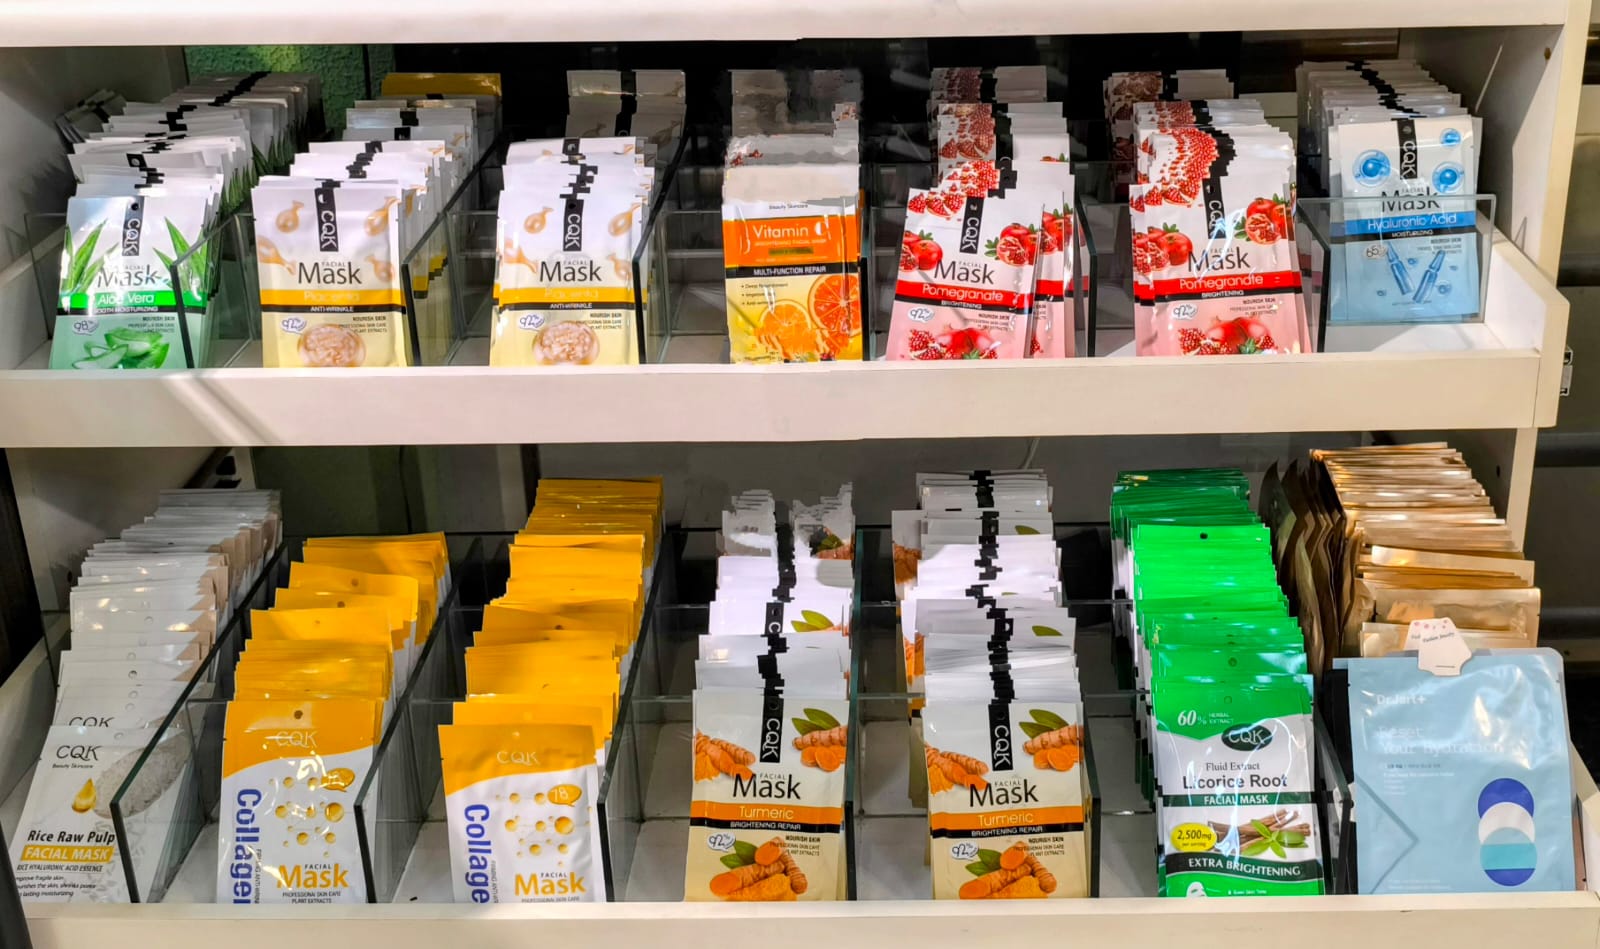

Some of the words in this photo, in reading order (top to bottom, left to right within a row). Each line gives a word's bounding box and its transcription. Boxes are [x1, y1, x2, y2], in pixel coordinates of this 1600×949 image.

[1401, 140, 1416, 177] CQK
[1381, 187, 1440, 213] Mask
[321, 210, 338, 249] CQK
[1368, 216, 1427, 231] Hyaluronic
[1430, 213, 1457, 225] Acid
[122, 218, 141, 256] CQK
[564, 213, 581, 249] CQK
[753, 224, 809, 239] Vitamin
[961, 217, 980, 251] CQK
[1392, 230, 1434, 238] MOISTURIZING
[958, 261, 983, 269] FACIAL
[1188, 246, 1251, 272] Mask
[97, 264, 159, 288] Mask
[298, 261, 363, 284] Mask
[540, 260, 602, 282] Mask
[754, 267, 803, 276] MULTI-FUNCTION
[804, 266, 827, 274] REPAIR
[934, 260, 995, 285] Mask
[1180, 275, 1264, 290] Pomegranate
[127, 294, 155, 304] Vera
[922, 284, 1004, 302] Pomegranate
[1201, 290, 1245, 298] BRIGHTENING
[941, 300, 983, 309] BRIGHTENING
[276, 731, 317, 748] CQK
[762, 718, 781, 759] CQK
[1228, 728, 1264, 745] CQK
[57, 745, 103, 761] CQK
[993, 725, 1011, 767] CQK
[1382, 742, 1417, 754] Your
[497, 751, 541, 766] CQK
[1205, 762, 1228, 772] Fluid
[1230, 762, 1260, 771] Extract
[733, 773, 801, 800] Mask
[1183, 775, 1244, 789] Licorice
[1250, 774, 1287, 788] Root
[970, 779, 1039, 807] Mask
[1204, 796, 1236, 805] FACIAL
[1239, 795, 1269, 804] MASK
[740, 806, 794, 820] Turmeric
[978, 812, 1034, 827] Turmeric
[27, 830, 54, 842] Rice
[57, 831, 85, 842] Raw
[87, 831, 115, 845] Pulp
[971, 827, 1018, 837] BRIGHTENING
[1019, 826, 1043, 834] REPAIR
[25, 847, 69, 860] FACIAL
[71, 848, 109, 860] MASK
[1188, 858, 1224, 869] EXTRA
[1226, 860, 1301, 876] BRIGHTENING
[277, 863, 349, 889] Mask
[514, 872, 586, 896] Mask
